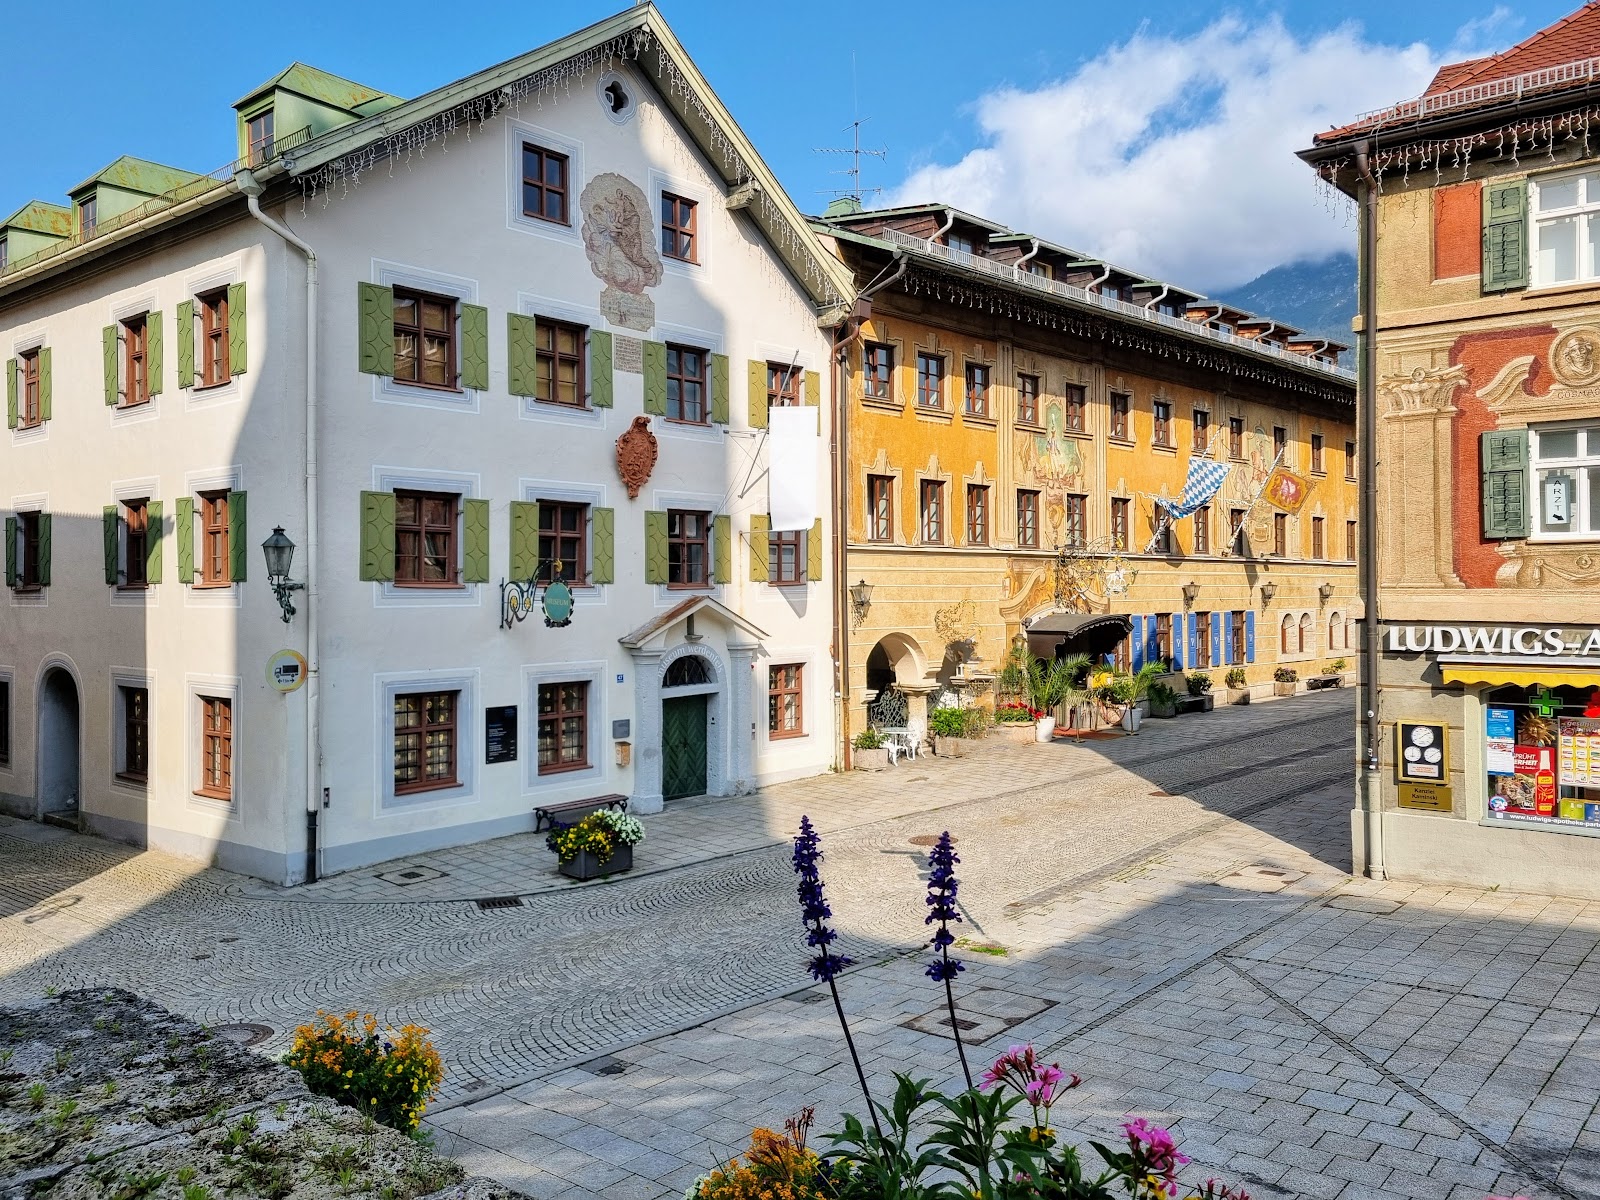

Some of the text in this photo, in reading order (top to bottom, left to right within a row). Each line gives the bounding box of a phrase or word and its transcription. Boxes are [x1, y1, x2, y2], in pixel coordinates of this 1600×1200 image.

[1553, 479, 1562, 511] ARZT
[1389, 625, 1600, 656] LUDWIGS-A
[658, 645, 723, 678] museum werdenfels
[1411, 793, 1438, 801] Kaminski
